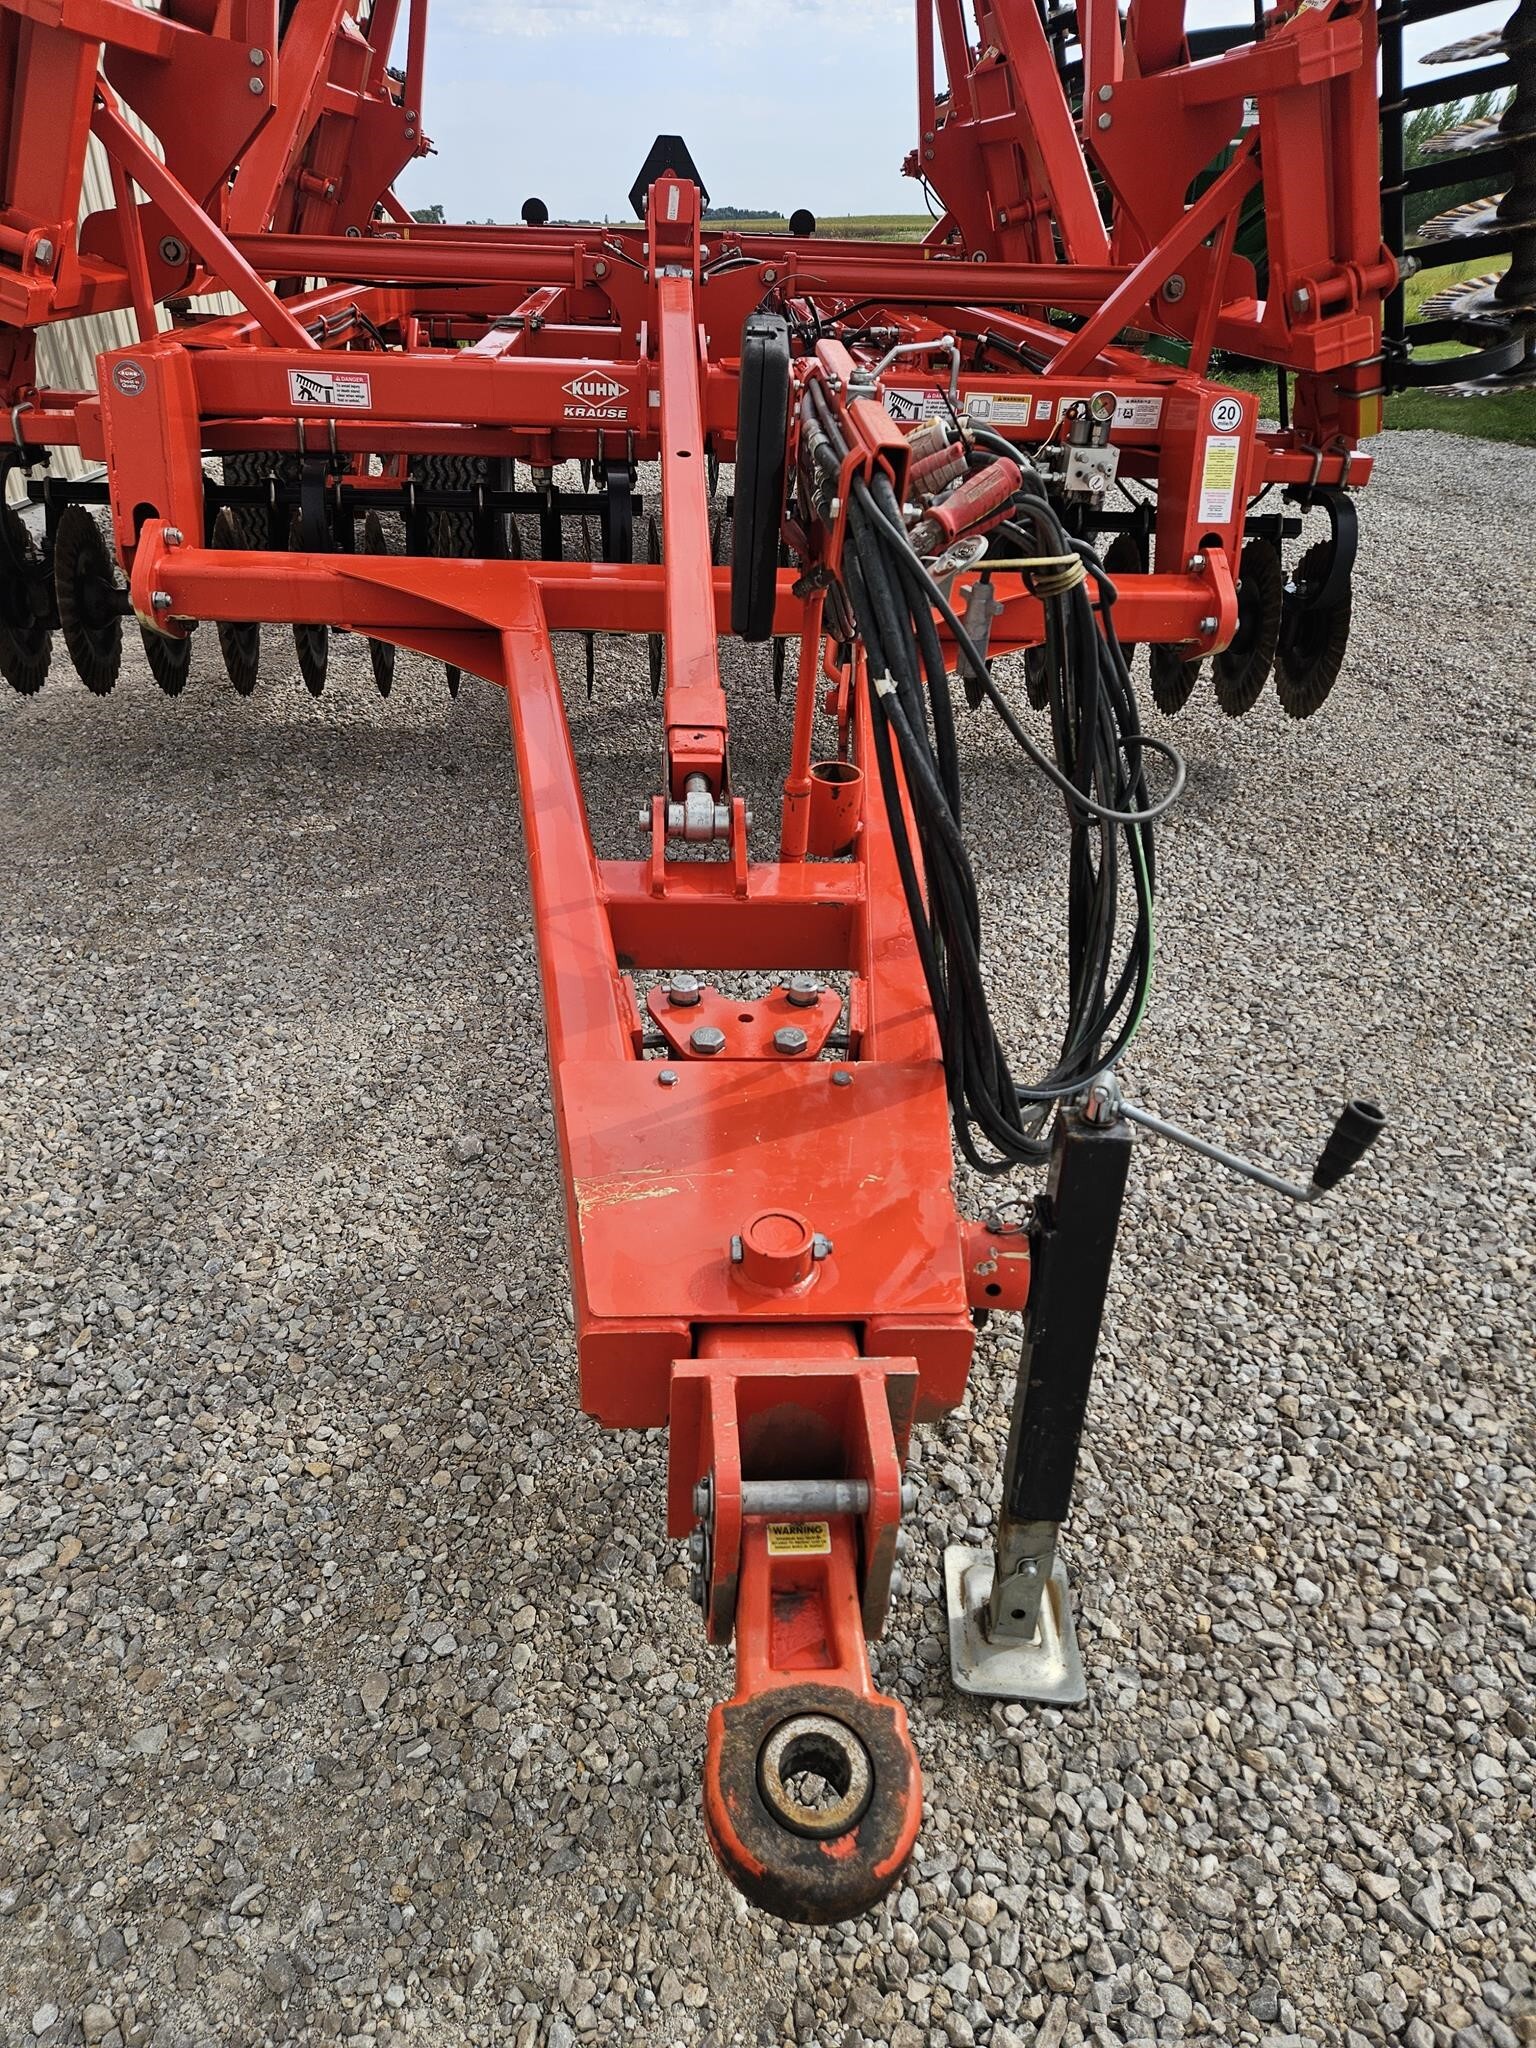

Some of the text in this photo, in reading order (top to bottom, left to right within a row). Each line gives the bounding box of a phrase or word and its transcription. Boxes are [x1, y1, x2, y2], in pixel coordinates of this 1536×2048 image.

[572, 381, 619, 397] KUHN
[564, 407, 627, 418] KRAUSE
[1217, 405, 1236, 420] 20
[773, 1526, 823, 1534] WARNING
